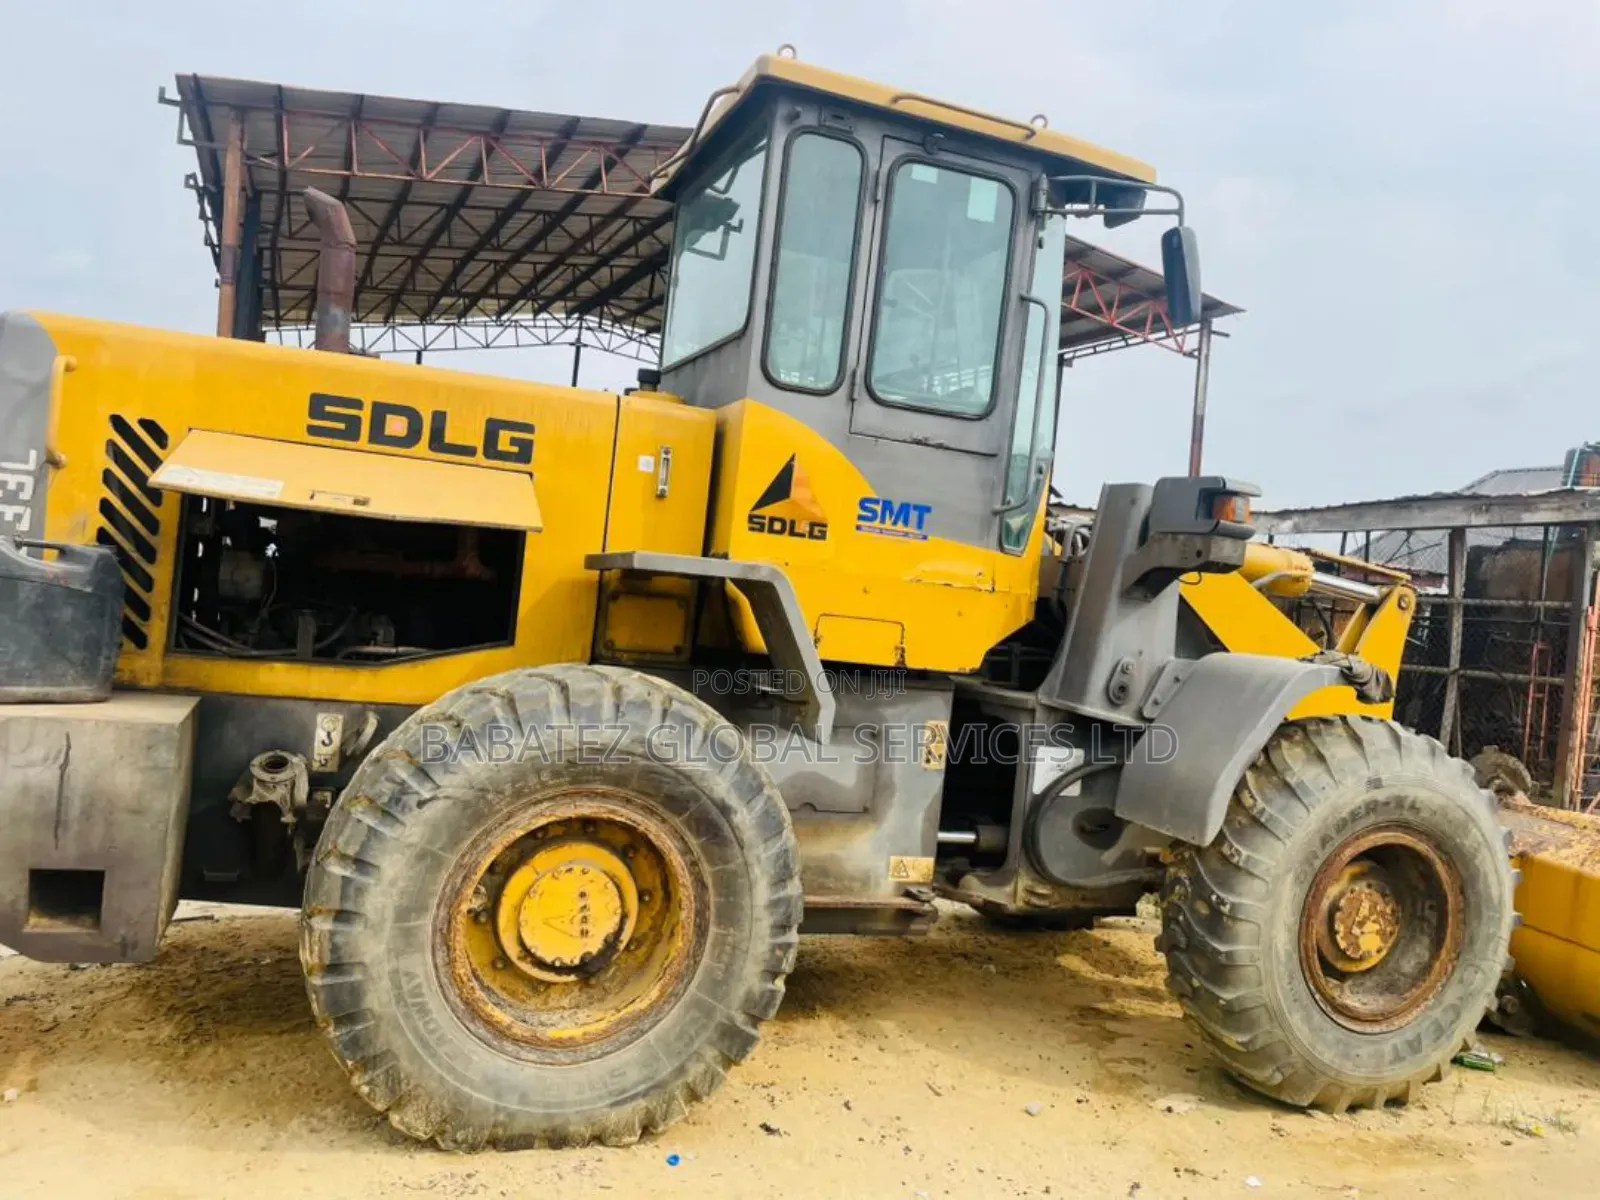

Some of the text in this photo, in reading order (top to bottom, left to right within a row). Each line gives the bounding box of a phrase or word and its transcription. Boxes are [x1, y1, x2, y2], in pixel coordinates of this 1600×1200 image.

[306, 393, 535, 464] SDLG
[748, 514, 828, 541] SDLG
[857, 498, 932, 530] SMT
